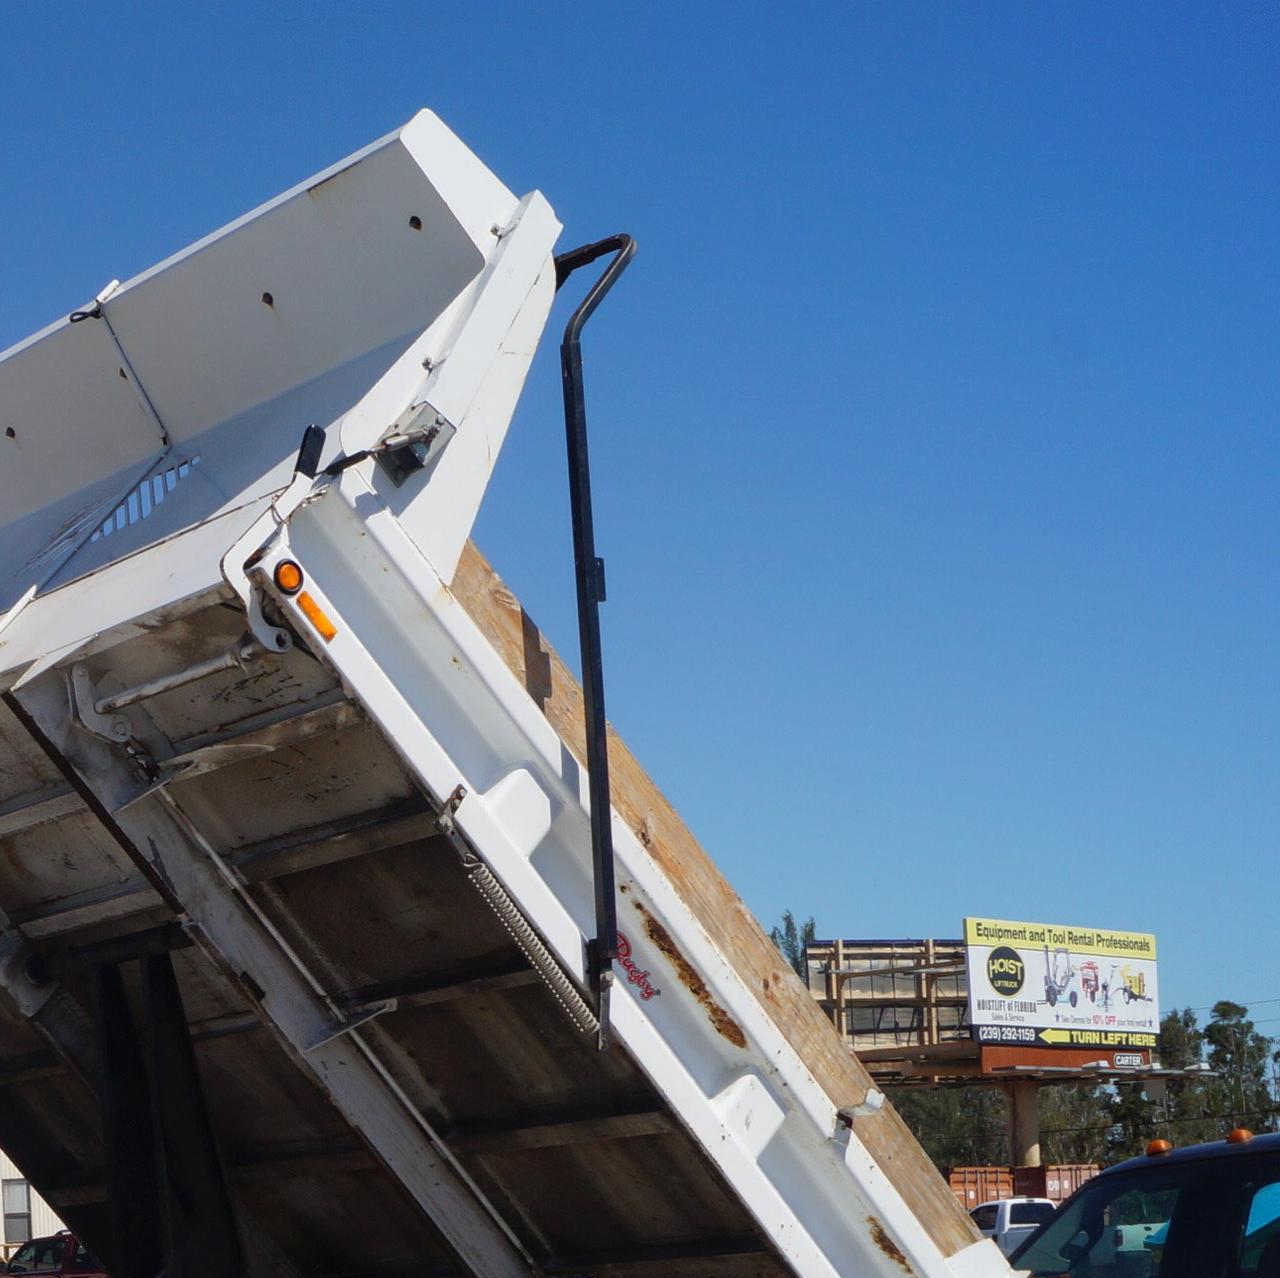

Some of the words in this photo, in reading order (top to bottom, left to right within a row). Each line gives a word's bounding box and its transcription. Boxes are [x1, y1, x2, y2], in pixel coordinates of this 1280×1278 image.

[976, 922, 1027, 941] Equipment
[1028, 928, 1046, 942] and
[1047, 929, 1066, 944] Tool
[1068, 931, 1095, 947] Rental
[1096, 933, 1151, 952] Professionals
[989, 958, 1023, 980] HOIST
[977, 999, 1006, 1011] HOISTLIFT
[1014, 1001, 1037, 1013] FLORIDA
[1104, 1015, 1117, 1026] OFF
[979, 1026, 1001, 1041] (239)
[1001, 1027, 1036, 1041] 292-1159
[1071, 1030, 1100, 1044] TURN
[1101, 1032, 1127, 1045] LEFT
[1128, 1034, 1157, 1047] HERE
[1115, 1055, 1141, 1066] CARTER
